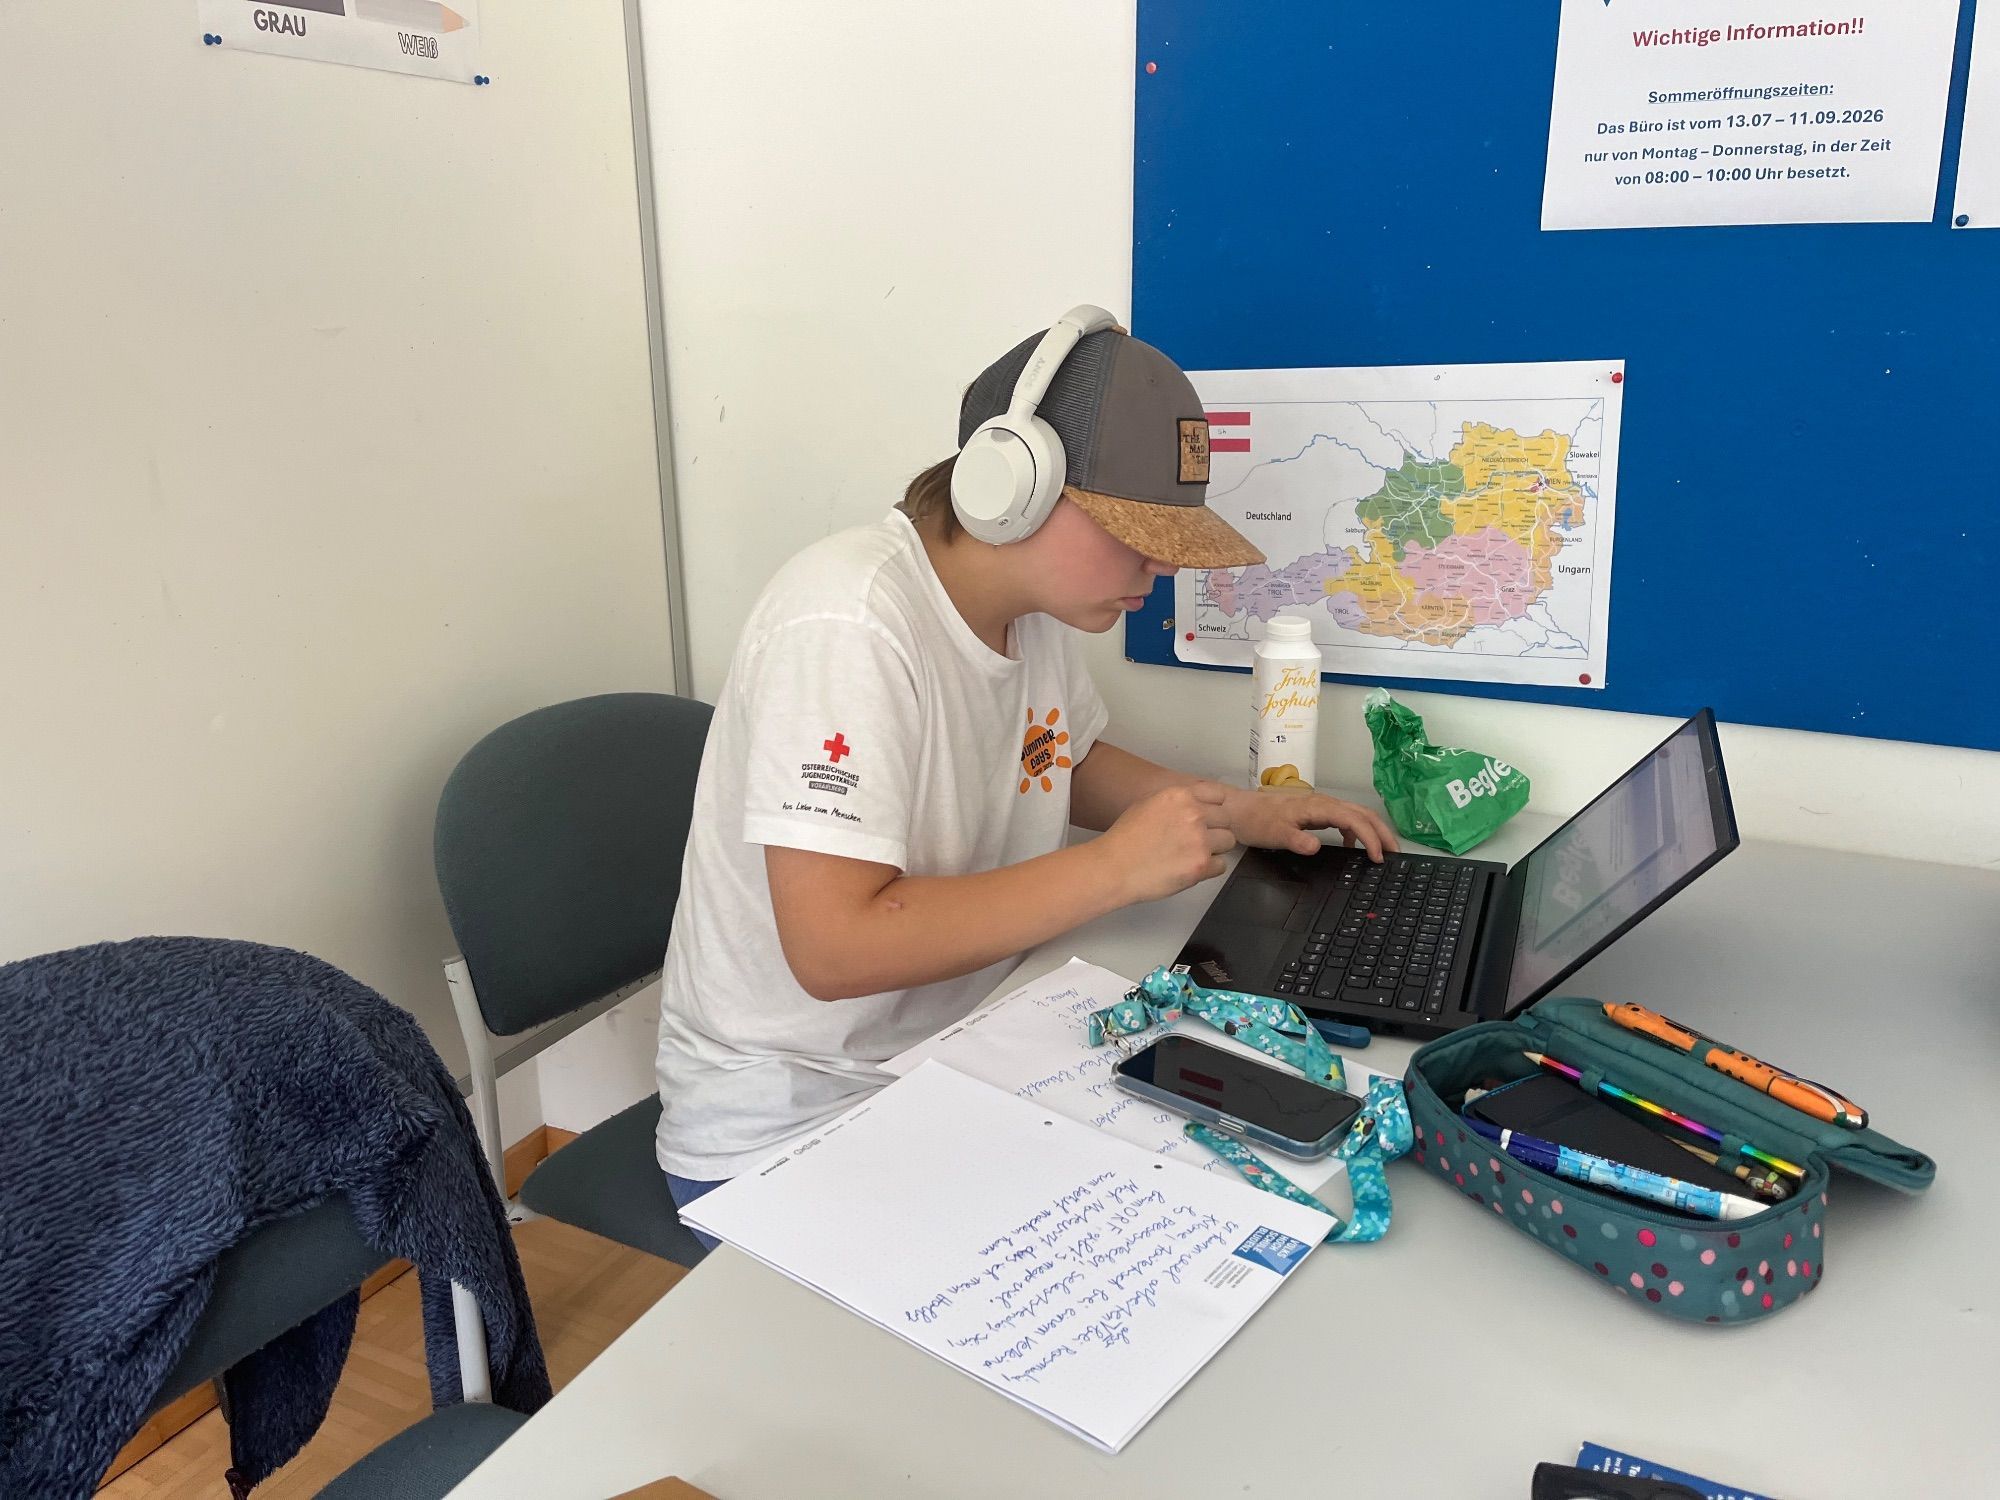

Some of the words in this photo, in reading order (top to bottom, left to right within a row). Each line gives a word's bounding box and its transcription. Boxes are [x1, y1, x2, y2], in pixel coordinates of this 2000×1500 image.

[254, 9, 306, 37] GRAU
[1633, 28, 1720, 47] Wichtige
[1727, 18, 1863, 41] Information!!
[1648, 83, 1833, 103] Sommeröffnungszeiten:
[1598, 123, 1624, 134] Das
[1629, 121, 1663, 132] Büro
[1667, 119, 1685, 131] ist
[1689, 120, 1721, 129] vom
[1727, 114, 1772, 128] 13.07
[1790, 109, 1883, 125] 11.09.2026
[1585, 153, 1609, 162] nur
[1612, 151, 1637, 161] von
[1642, 148, 1698, 160] Montag
[1713, 143, 1807, 156] Donnerstag,
[1812, 141, 1825, 152] in
[1831, 140, 1857, 152] der
[1860, 139, 1891, 151] Zeit
[1615, 176, 1640, 185] von
[1645, 170, 1689, 184] 08:00
[1707, 168, 1751, 181] 10:00
[1756, 168, 1783, 180] Uhr
[1787, 167, 1850, 179] besetzt.
[1569, 451, 1600, 459] Slowakei
[1245, 511, 1292, 521] Deutschland
[1558, 565, 1591, 576] Ungarn
[1198, 623, 1227, 633] Schweiz
[1273, 667, 1317, 692] Trink
[1259, 690, 1319, 720] Joghur
[801, 763, 860, 782] ÖSTERREICHISCHES
[801, 771, 858, 788] JUGENDROTKREUZ
[1446, 757, 1512, 809] Begle
[782, 802, 793, 811] Aus
[814, 806, 828, 815] zum
[1107, 1207, 1138, 1235] ORF
[1238, 1227, 1269, 1253] BLUDENZ
[1252, 1230, 1279, 1253] SCHULE
[1269, 1235, 1289, 1252] HOCH
[1277, 1239, 1300, 1259] VOLKS
